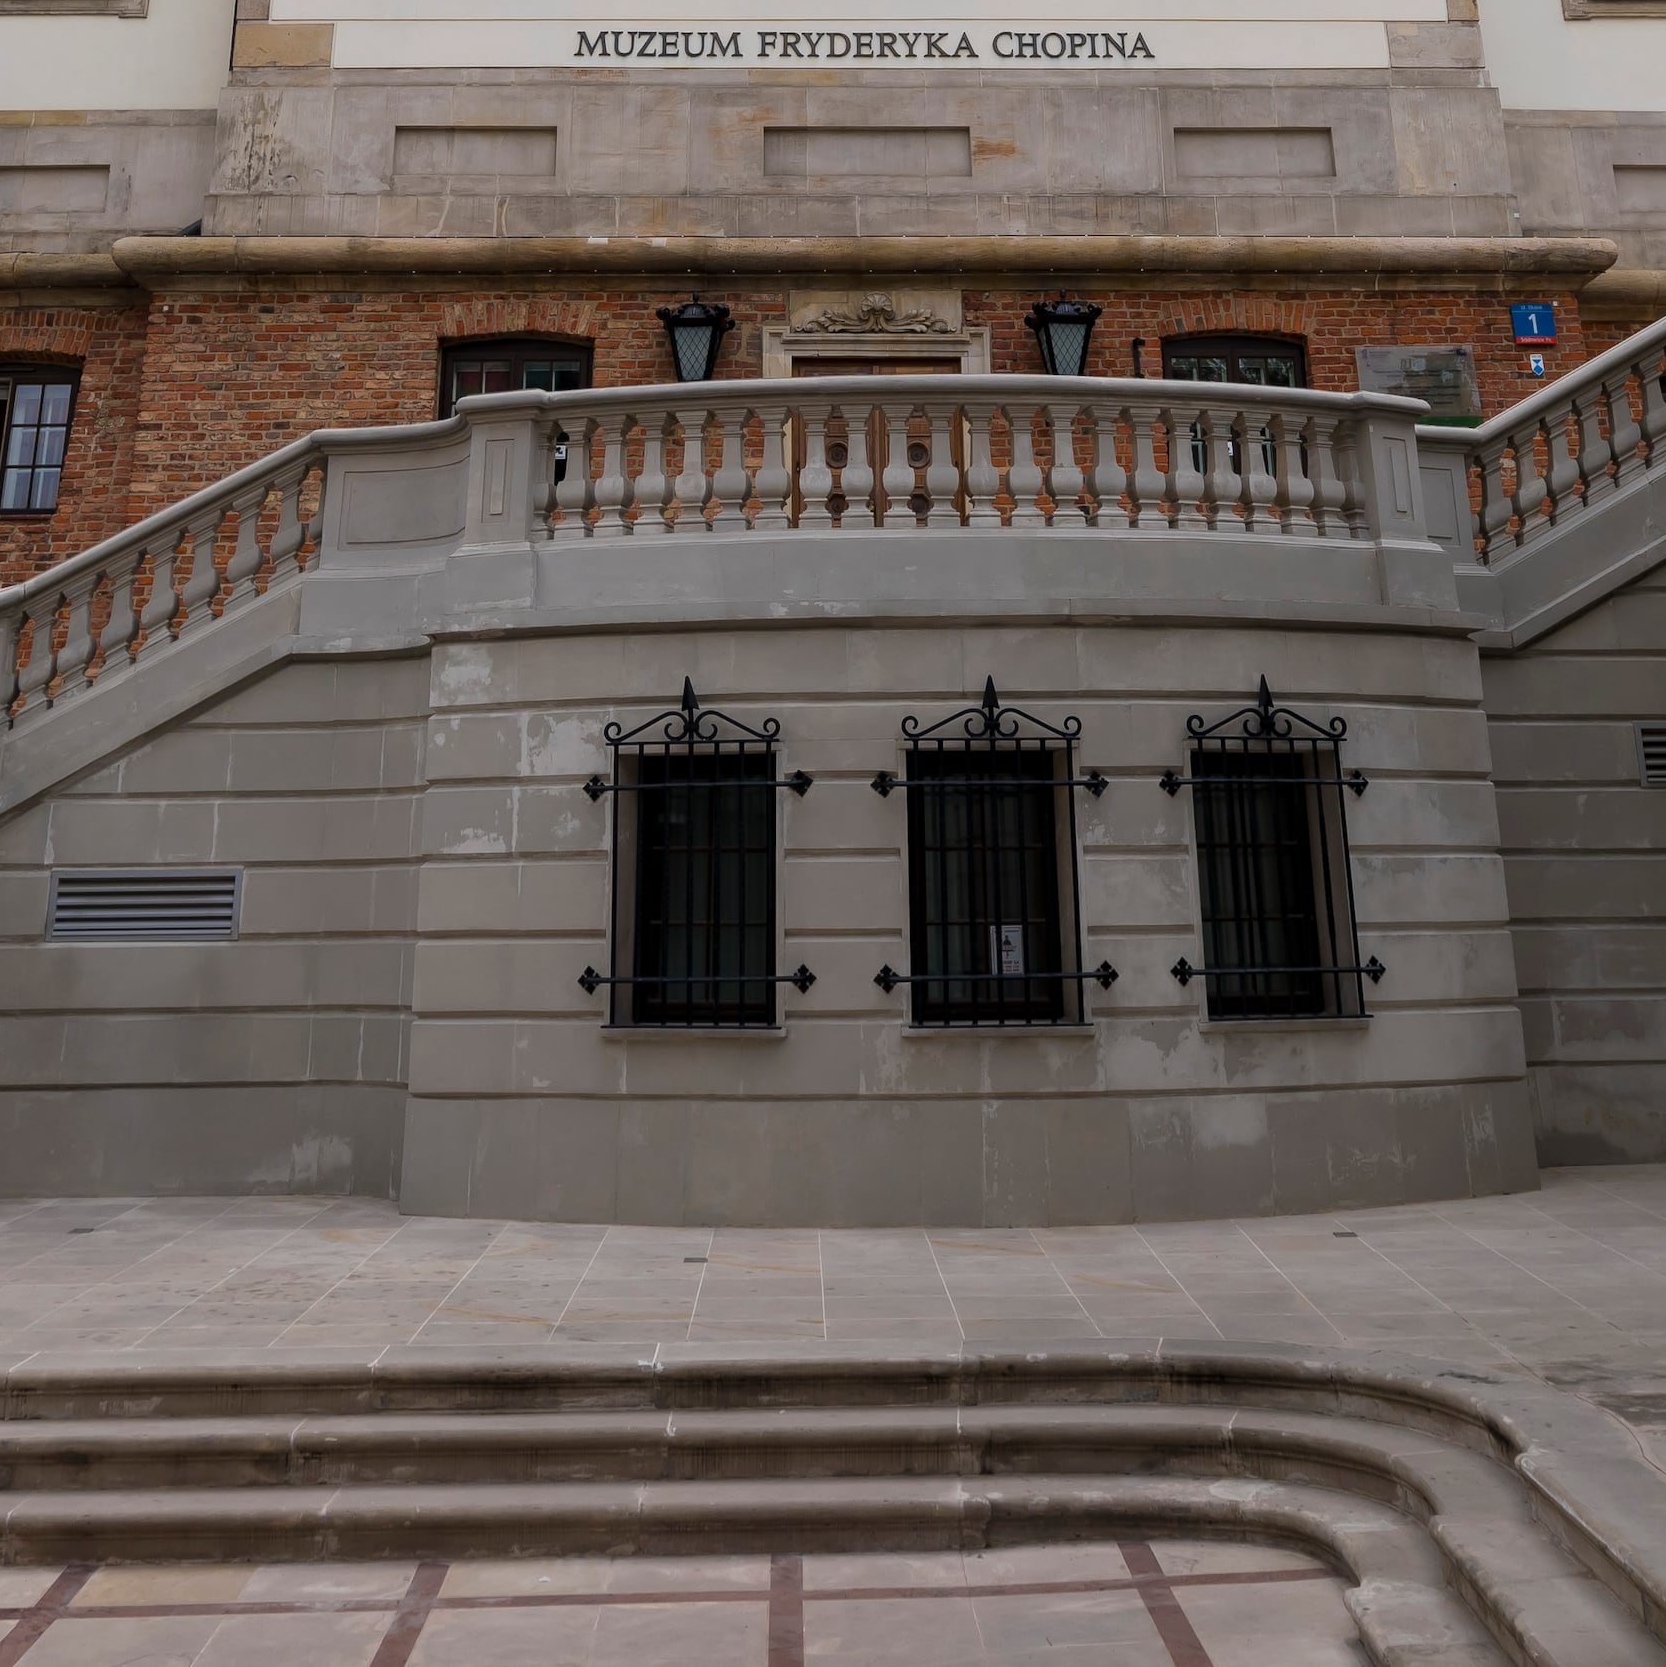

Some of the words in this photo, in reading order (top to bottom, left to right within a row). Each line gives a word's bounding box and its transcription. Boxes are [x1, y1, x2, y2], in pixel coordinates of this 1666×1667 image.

[574, 30, 743, 59] MUZEUM
[757, 30, 980, 60] FRYDERYKA
[992, 30, 1156, 60] CHOPINA
[1528, 313, 1539, 335] 1
